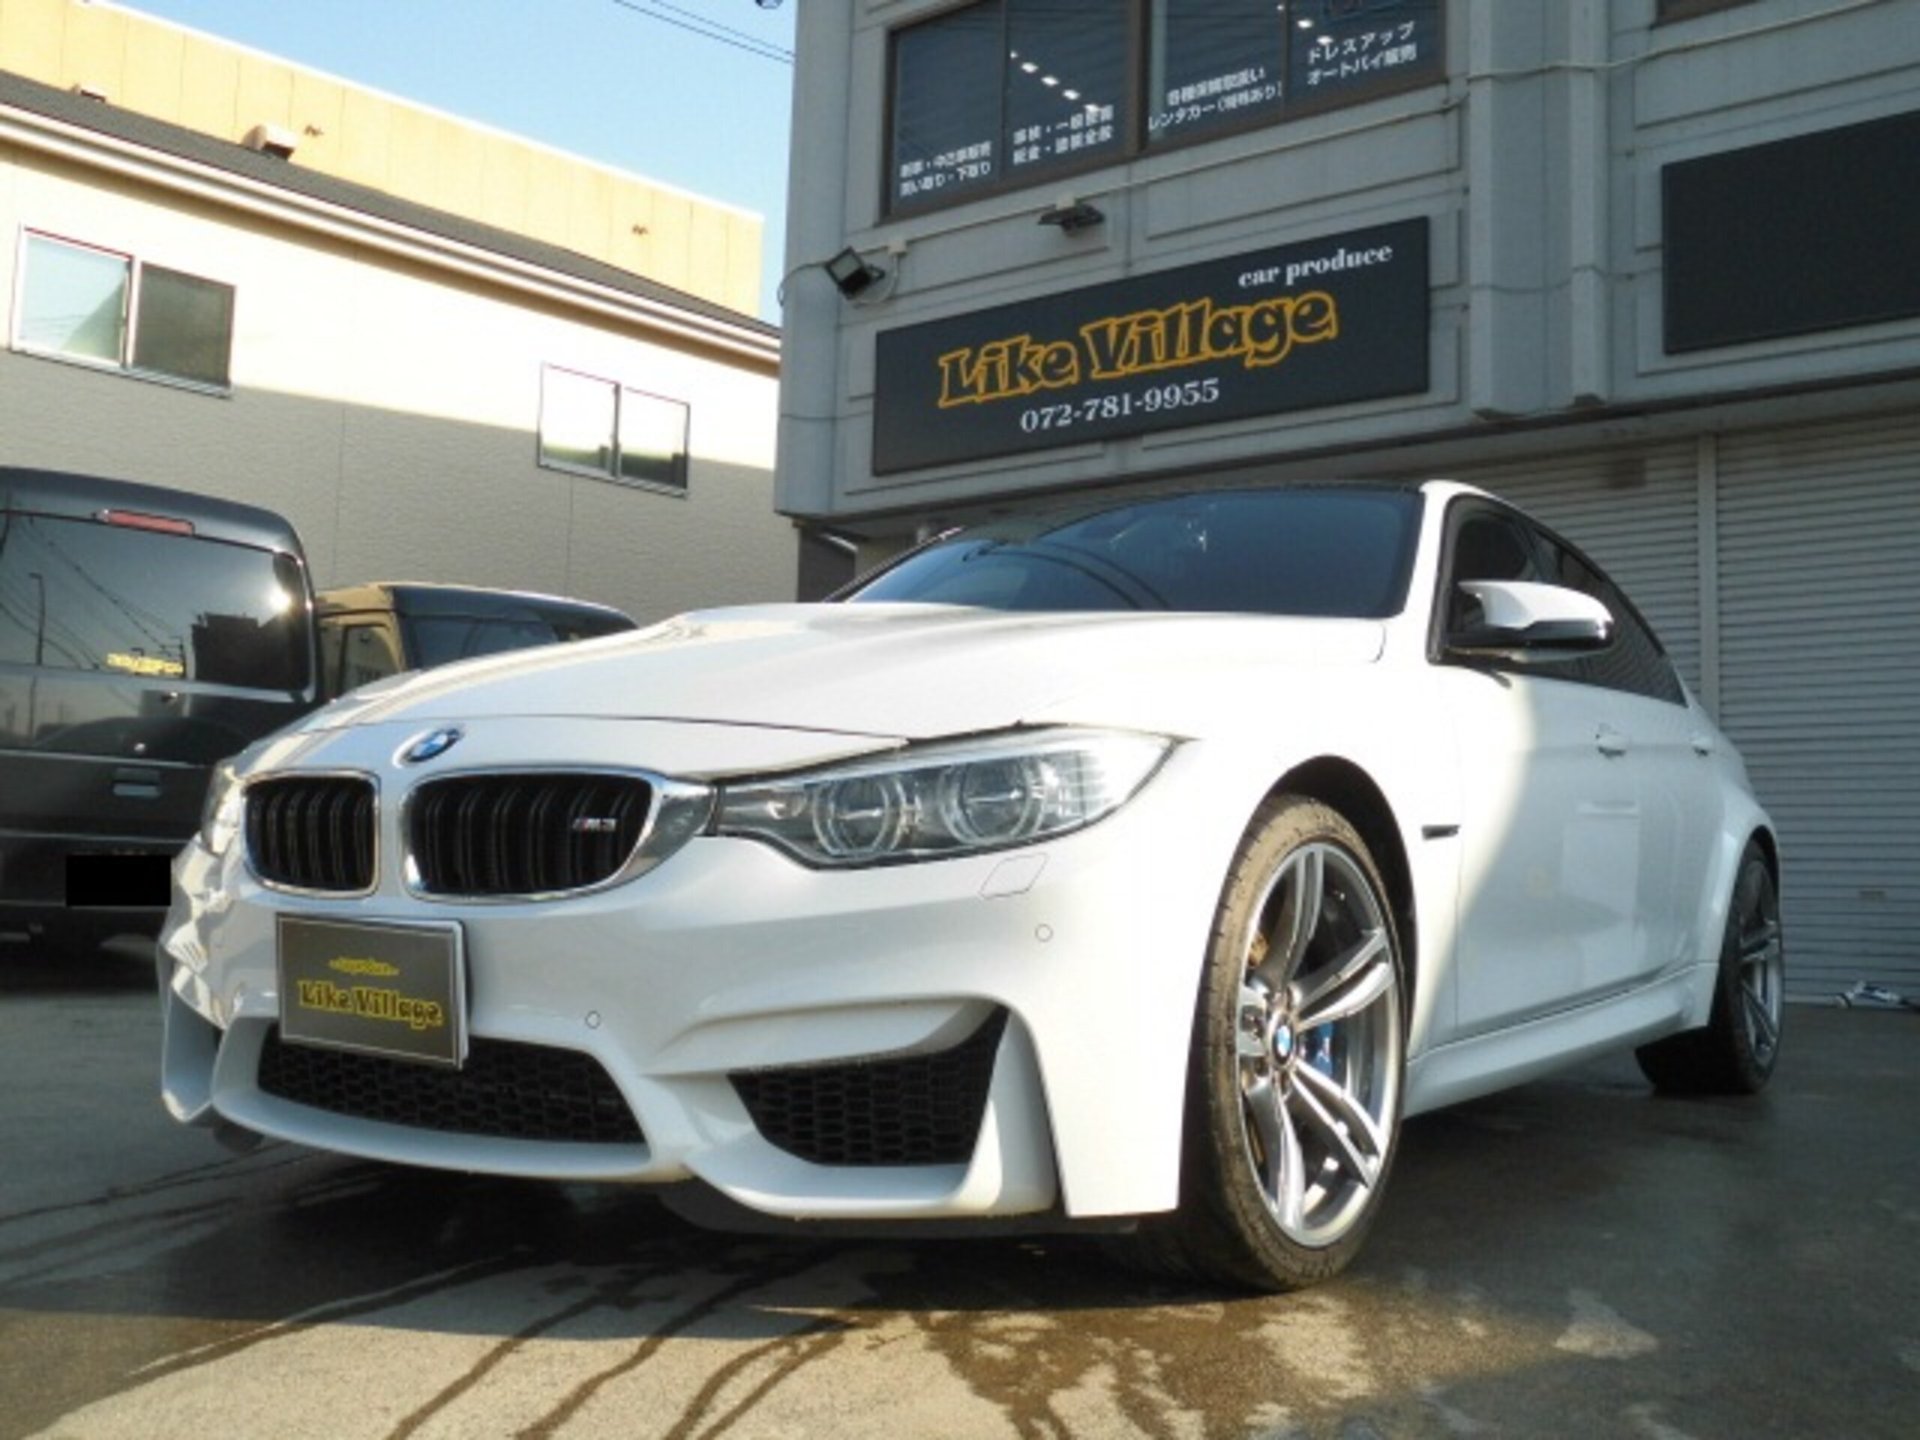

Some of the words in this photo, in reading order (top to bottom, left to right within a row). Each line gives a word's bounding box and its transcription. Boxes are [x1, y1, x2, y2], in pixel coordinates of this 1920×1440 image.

[1308, 21, 1414, 64] ドレスアップ
[1238, 267, 1280, 289] car
[1285, 243, 1394, 286] produce
[938, 334, 1081, 409] Like
[1081, 290, 1339, 379] Village
[1020, 377, 1221, 433] 072-781-9955
[298, 979, 352, 1014] Like
[351, 985, 443, 1031] Village
